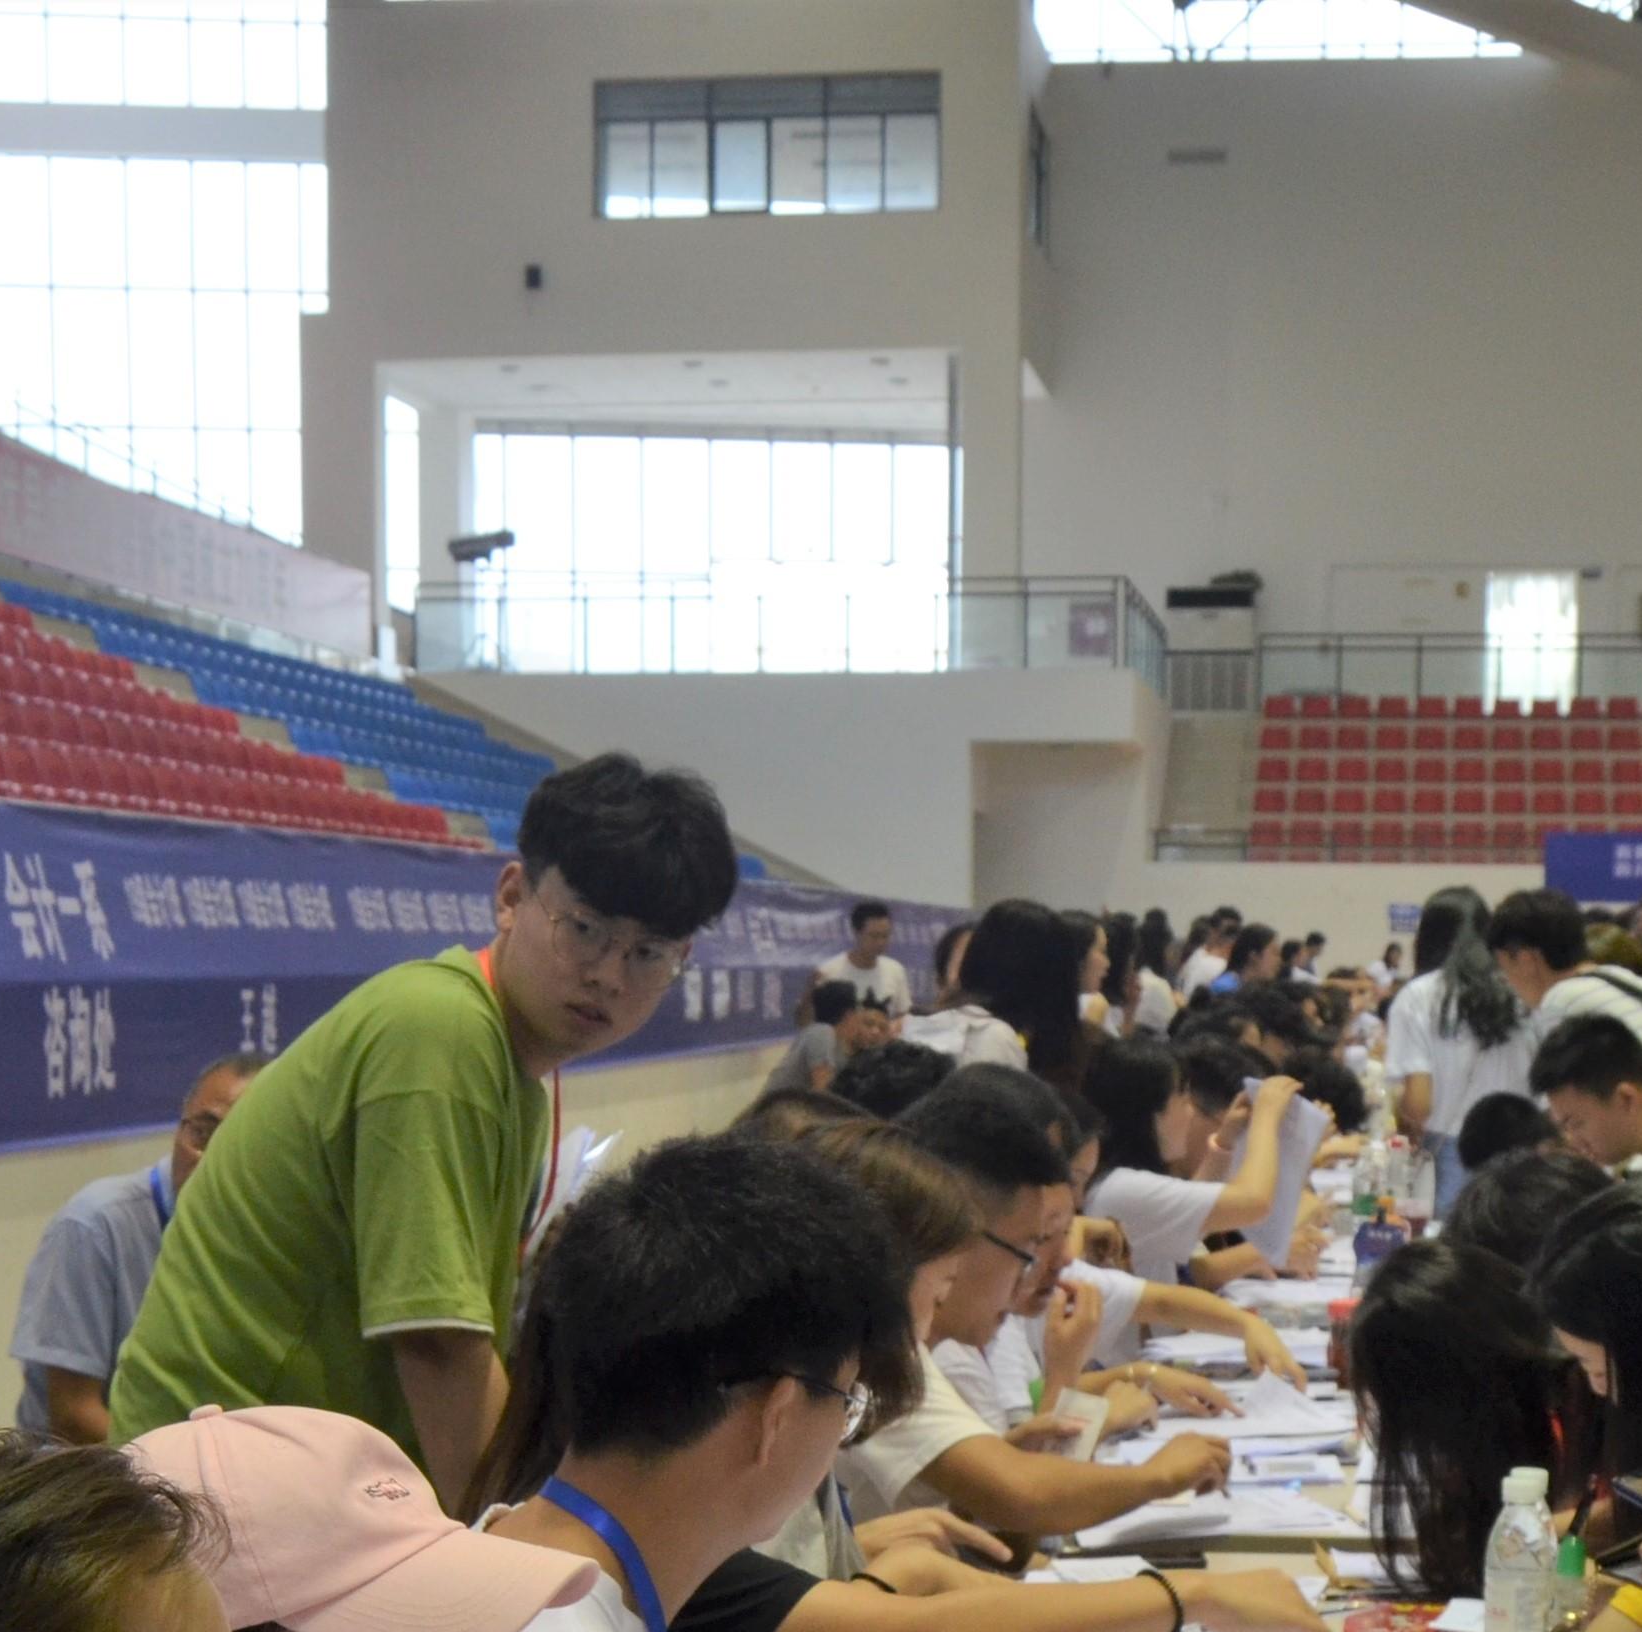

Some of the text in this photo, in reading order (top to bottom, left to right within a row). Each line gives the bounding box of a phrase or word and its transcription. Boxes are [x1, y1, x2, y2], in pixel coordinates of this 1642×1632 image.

[5, 852, 116, 965] 会计一系
[42, 984, 117, 1099] 咨询处
